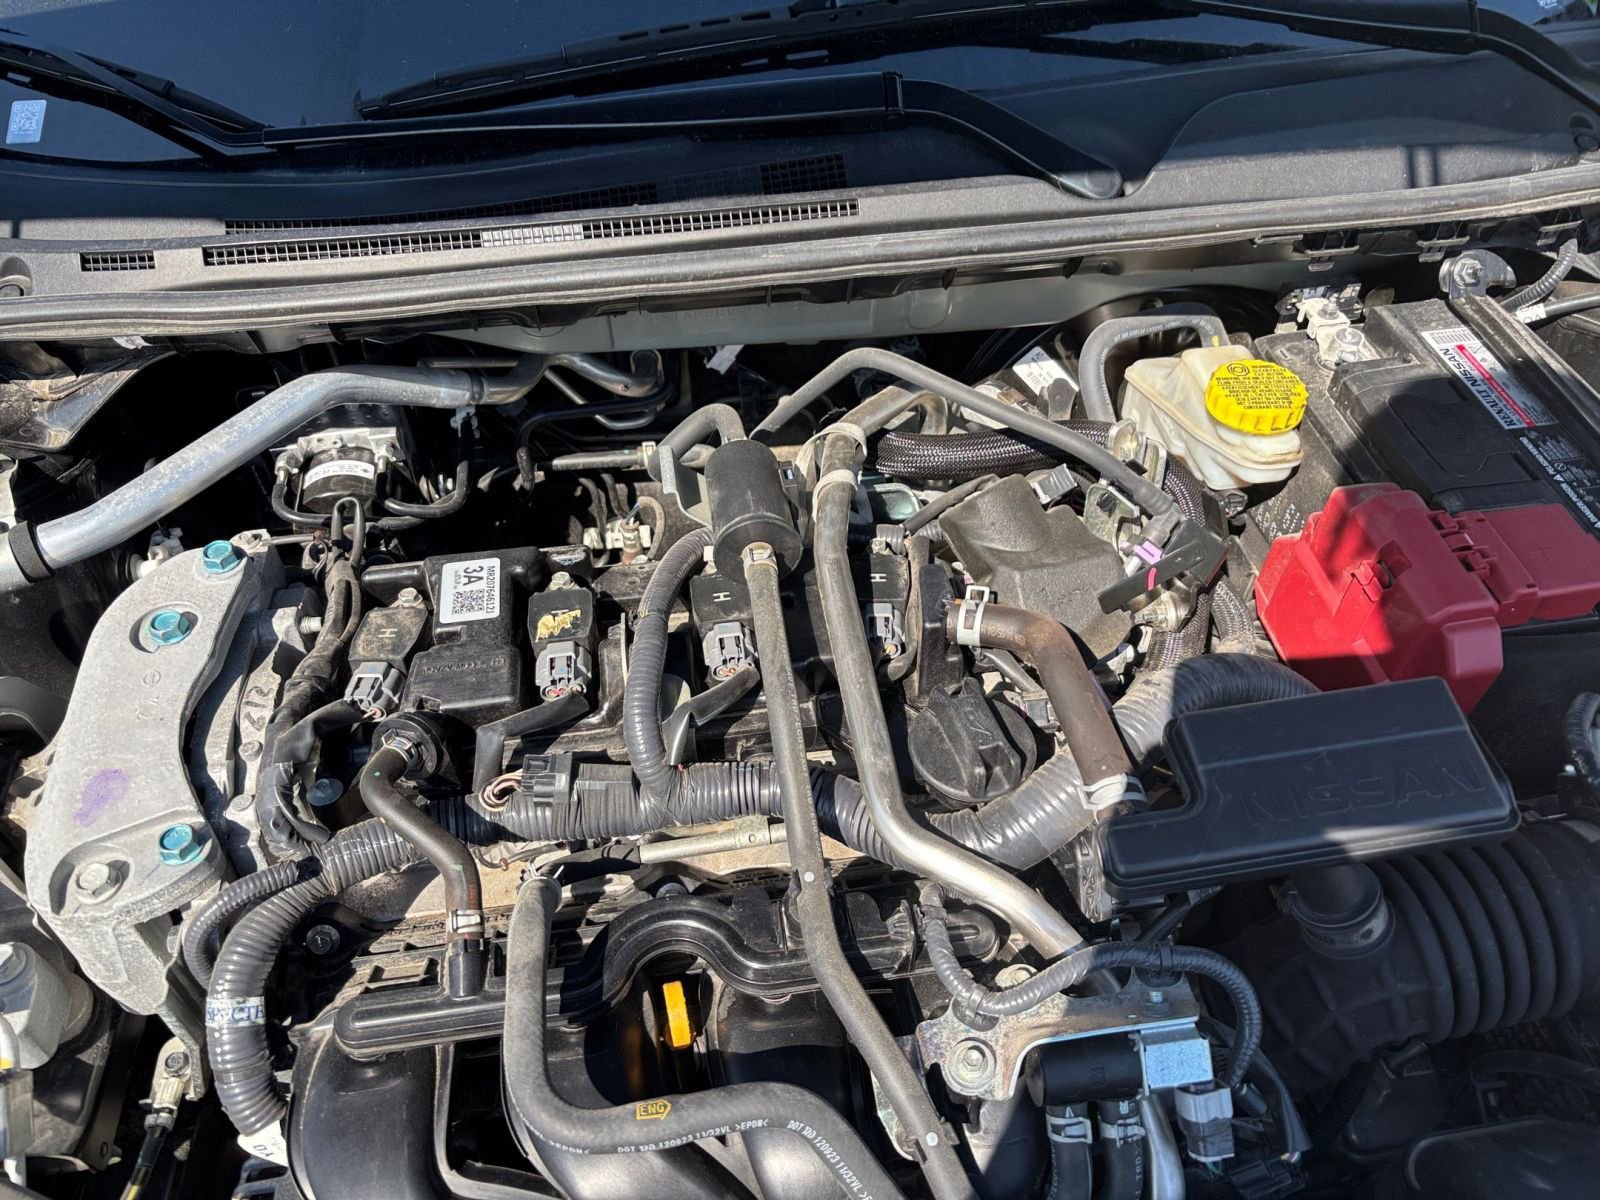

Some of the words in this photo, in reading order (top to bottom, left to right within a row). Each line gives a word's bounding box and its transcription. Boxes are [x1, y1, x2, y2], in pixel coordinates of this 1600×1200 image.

[1440, 348, 1481, 388] NISSAN
[1475, 385, 1517, 428] RENAULT
[463, 565, 484, 586] 3A
[712, 591, 731, 602] H
[378, 628, 398, 637] H
[1242, 756, 1487, 828] NISSAN
[641, 1102, 665, 1116] ENG
[617, 1145, 635, 1154] DOT
[658, 1134, 694, 1151] 120923
[695, 1124, 733, 1139] 11/32VL
[787, 1119, 804, 1132] DOT
[813, 1135, 840, 1164] 120923
[835, 1159, 864, 1193] 11/32VL
